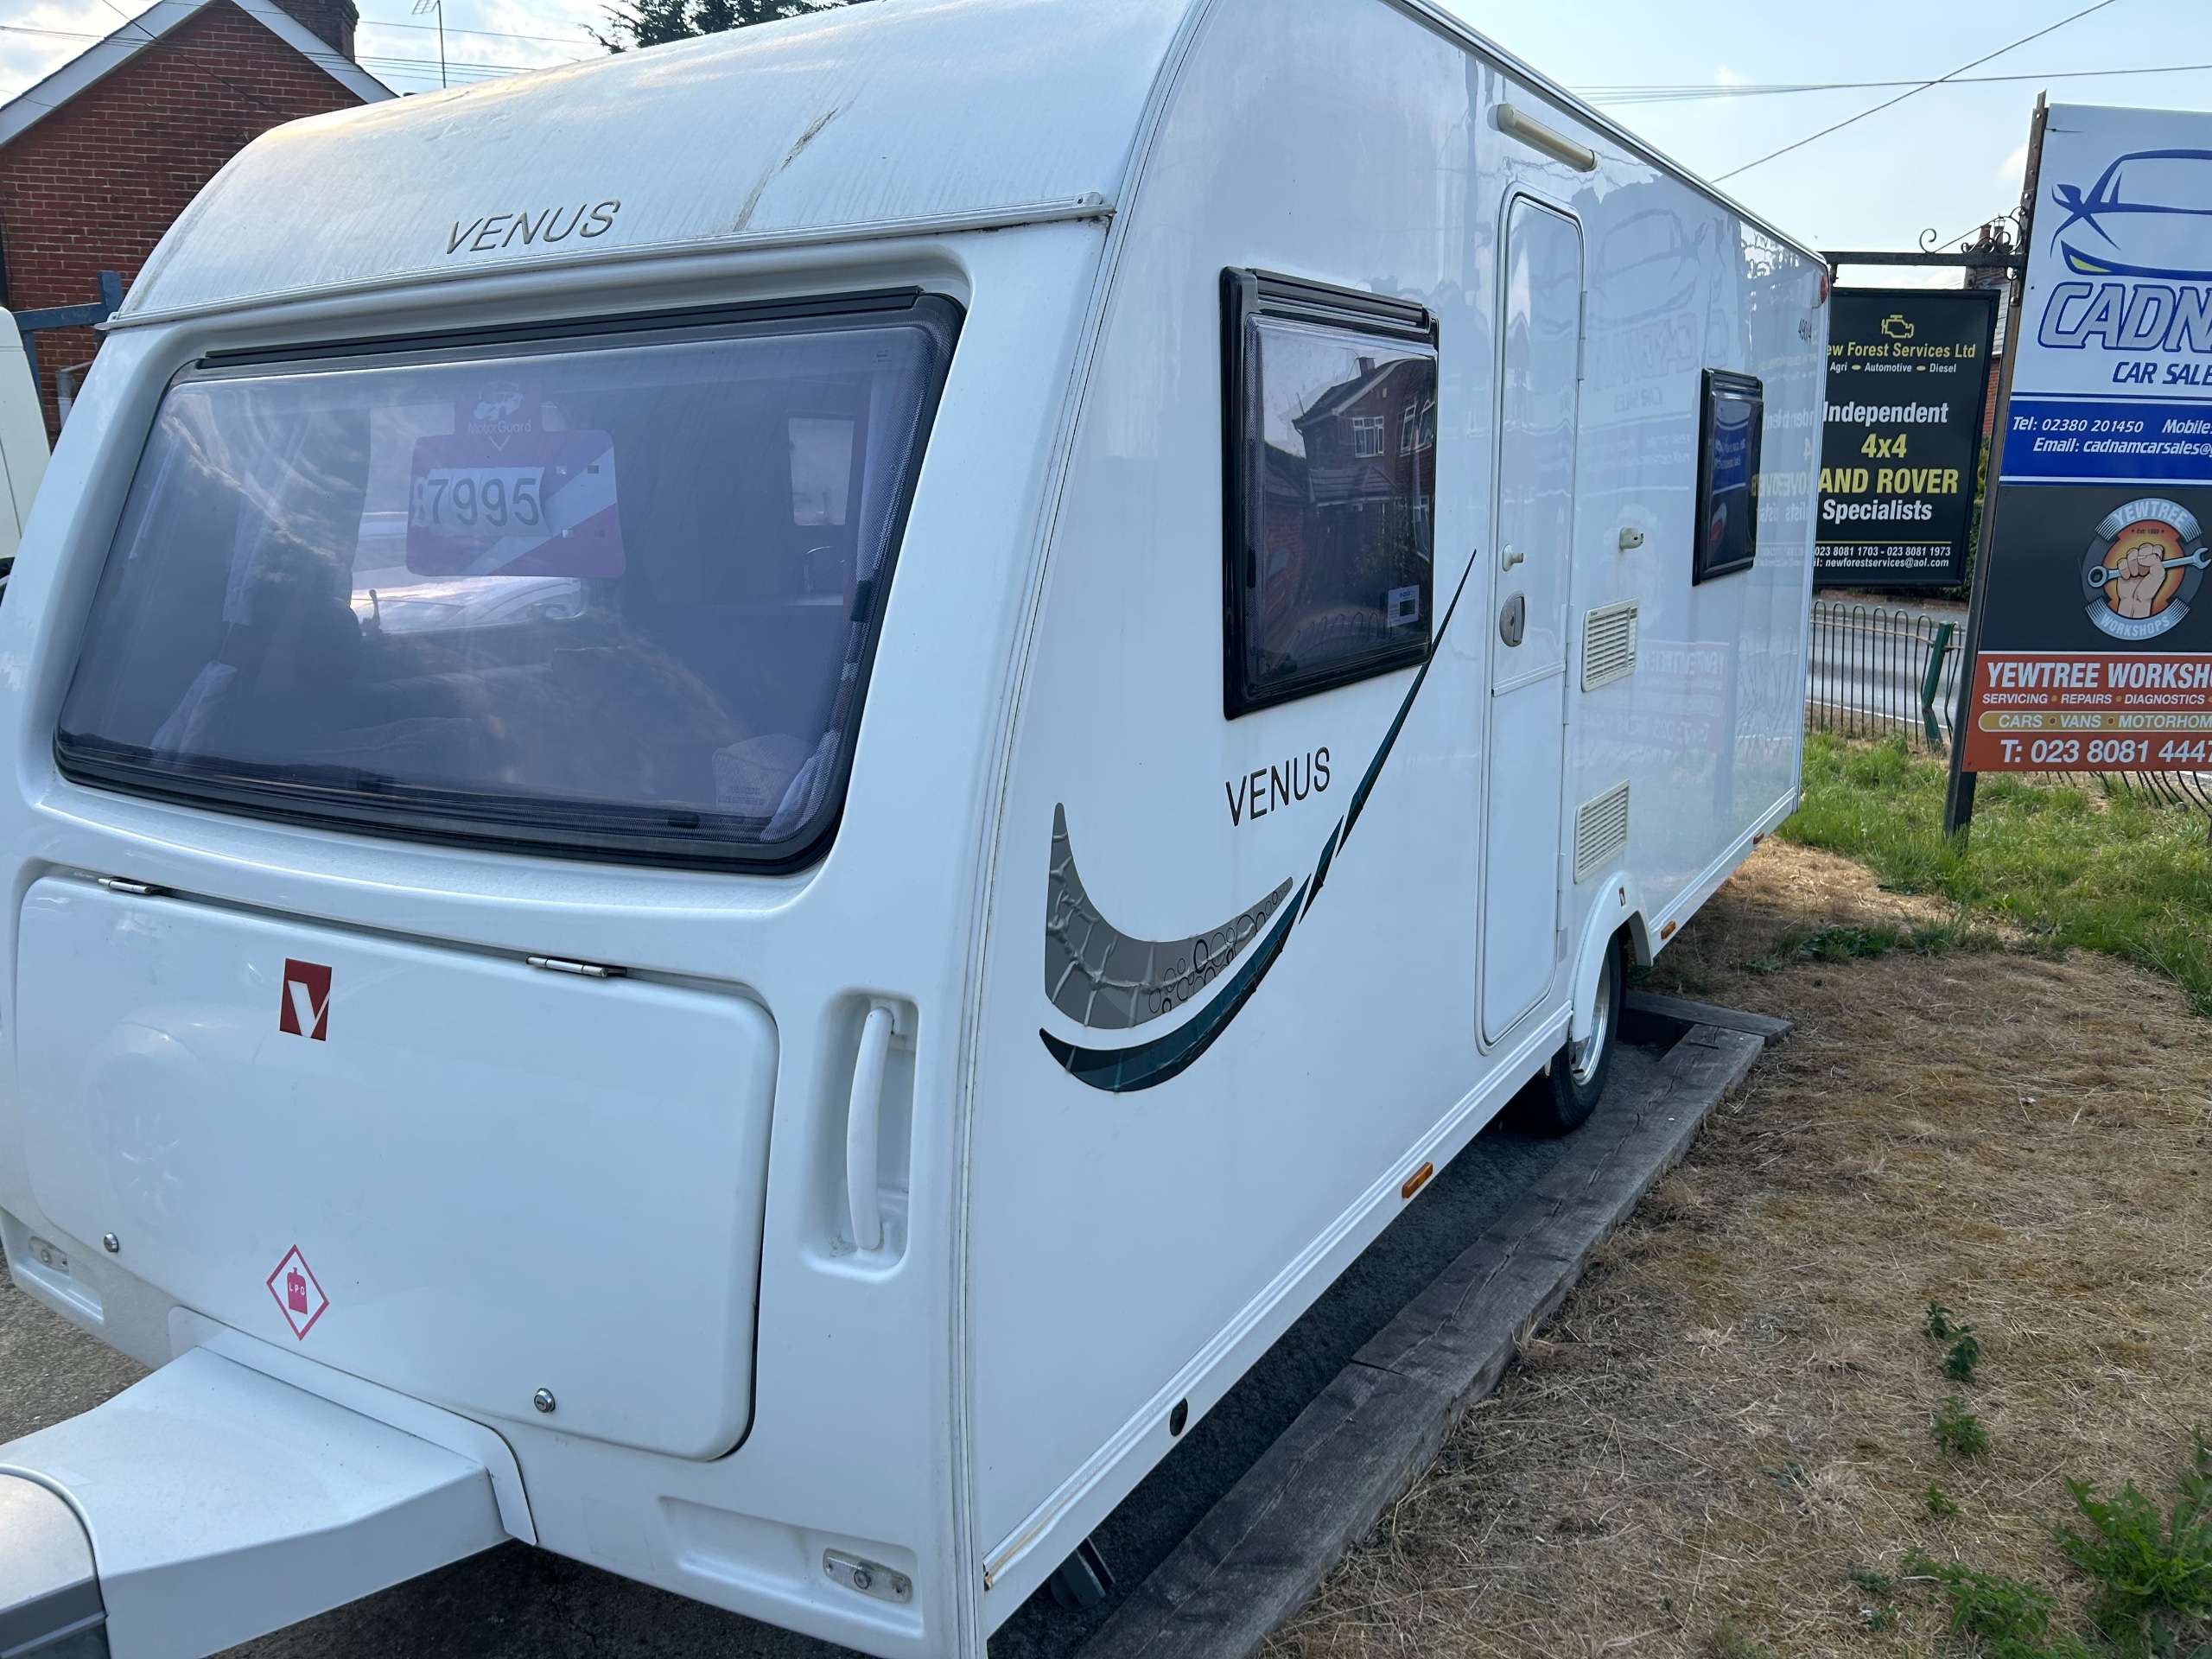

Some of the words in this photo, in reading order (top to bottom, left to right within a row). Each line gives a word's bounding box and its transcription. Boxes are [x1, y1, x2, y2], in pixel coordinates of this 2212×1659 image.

[446, 200, 621, 255] VENUS
[1826, 345, 1844, 357] ew
[1847, 341, 1889, 357] Forest
[1892, 342, 1950, 359] Services
[1955, 344, 1976, 359] Ltd
[1829, 361, 1848, 374] Agri
[1864, 361, 1912, 373] Automotive
[1929, 363, 1957, 373] Diesel
[2113, 361, 2158, 384] CAR
[1823, 401, 1949, 427] Independent
[2012, 416, 2037, 431] Tel:
[2042, 418, 2088, 431] 02380
[2091, 419, 2144, 433] 201450
[467, 418, 532, 434] MotorGuard
[1861, 434, 1908, 459] 4x4
[2033, 437, 2080, 453] Email:
[1818, 467, 1869, 493] AND
[1877, 467, 1960, 494] ROVER
[428, 477, 540, 528] 7995
[1822, 499, 1934, 524] Specialists
[2111, 499, 2189, 527] YEWTREE
[1815, 546, 1831, 556] 023
[1833, 546, 1854, 556] 8081
[1858, 546, 1878, 556] 1703
[1886, 546, 1904, 556] 023
[1905, 546, 1926, 556] 8081
[1929, 546, 1951, 556] 1973
[1825, 557, 1949, 568] newforestservices@aol.com
[2100, 615, 2171, 638] WORKSHOPS
[1987, 663, 2101, 688] YEWTREE
[2107, 663, 2212, 689] WORKSH
[1982, 694, 2048, 704] SERVICING
[2060, 694, 2112, 704] REPAIRS
[2124, 694, 2205, 705] DIAGNOSTICS
[1999, 715, 2043, 728] CARS
[2060, 715, 2101, 728] VANS
[2000, 740, 2022, 763] T:
[2031, 740, 2080, 763] 023
[2087, 740, 2149, 763] 8081
[1225, 747, 1331, 827] VENUS
